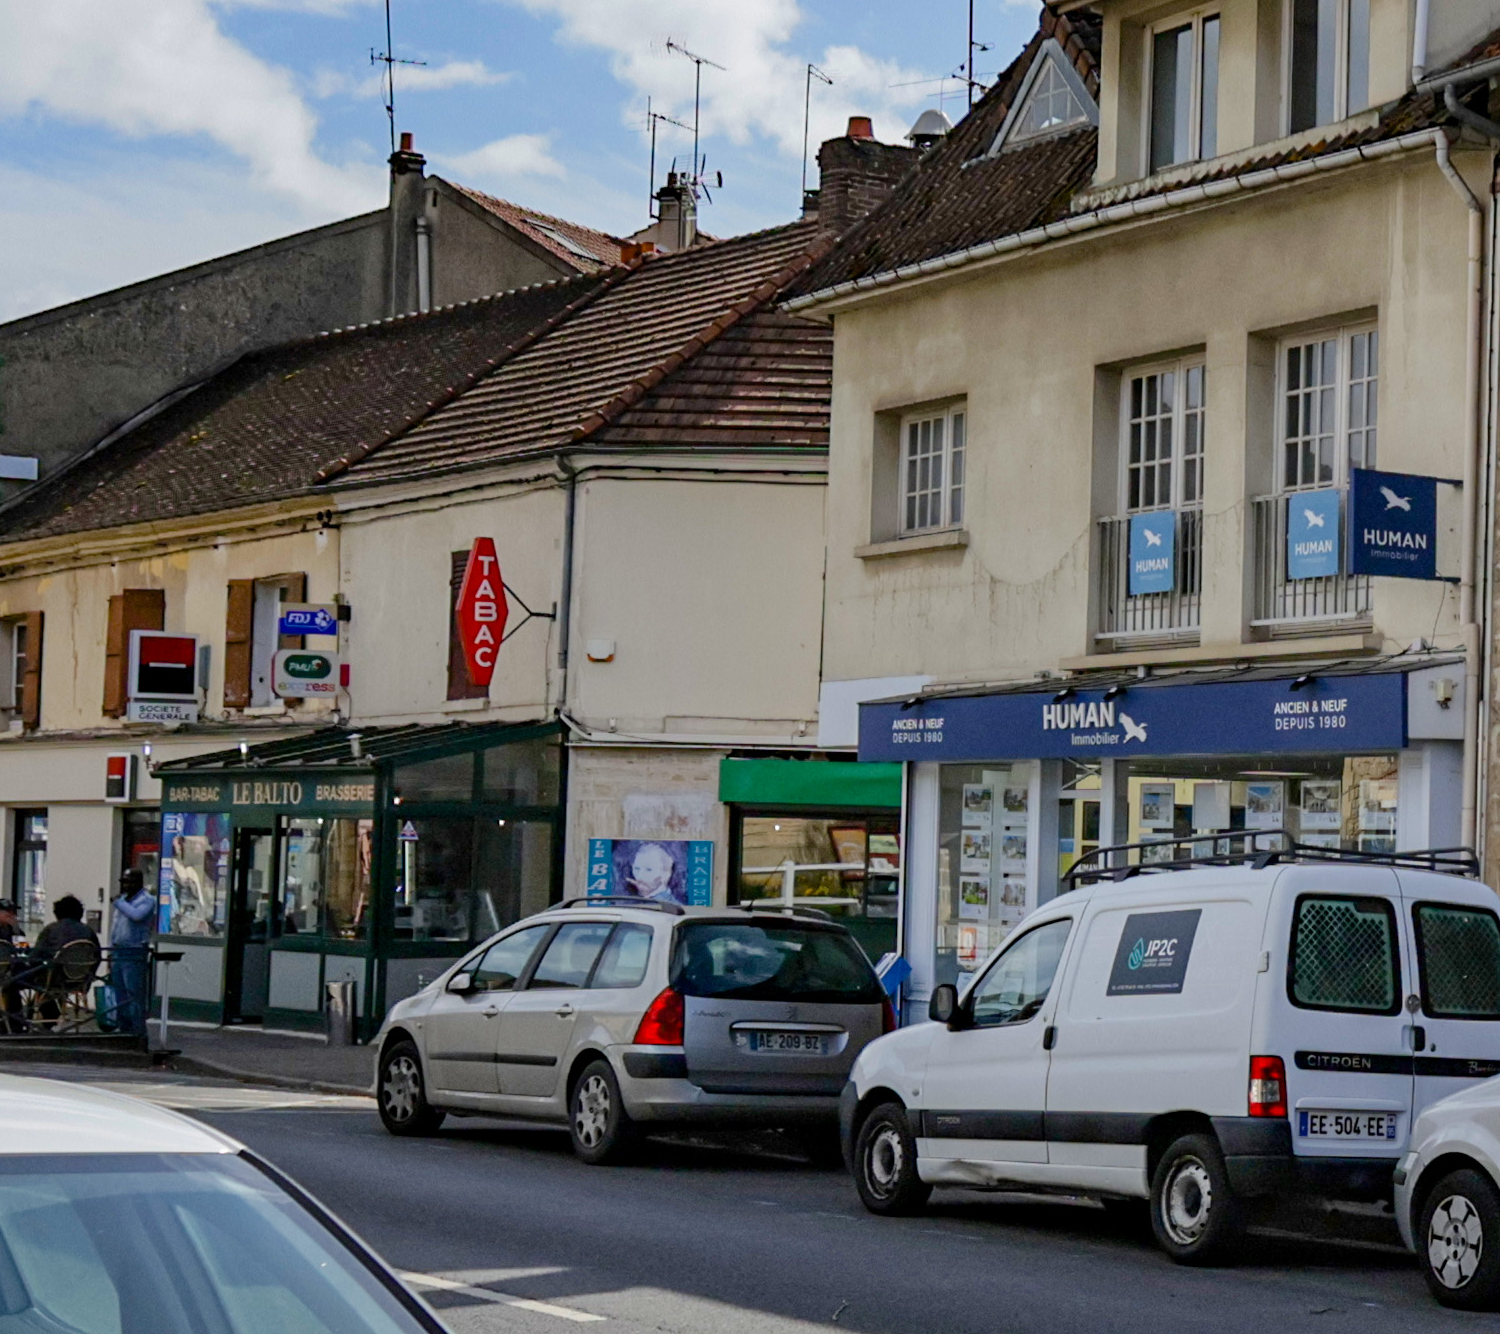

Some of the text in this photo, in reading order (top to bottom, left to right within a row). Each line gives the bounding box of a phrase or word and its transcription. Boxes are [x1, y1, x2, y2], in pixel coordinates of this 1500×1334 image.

[1363, 528, 1427, 549] HUMAN
[1295, 540, 1333, 555] HUMAN
[1135, 557, 1169, 573] HUMAN
[288, 613, 311, 624] FDJ
[474, 555, 498, 668] TABAC
[288, 662, 312, 672] PMU
[1273, 699, 1347, 715] ANCIEN & NEUF
[892, 718, 944, 730] ANCIEN & NEUF
[1042, 701, 1115, 731] HUMAN
[1275, 715, 1346, 730] DEPUIS 1980
[892, 731, 943, 744] DEPUIS 1980
[1071, 733, 1120, 746] Immobilier
[169, 786, 220, 802] BAR-TABAC
[232, 781, 302, 805] LE BALTO
[315, 784, 375, 802] BRASSERIE
[1144, 938, 1179, 957] JP2C
[758, 1033, 820, 1050] AE-209-BZ
[1310, 1114, 1385, 1137] EE-504-EE
